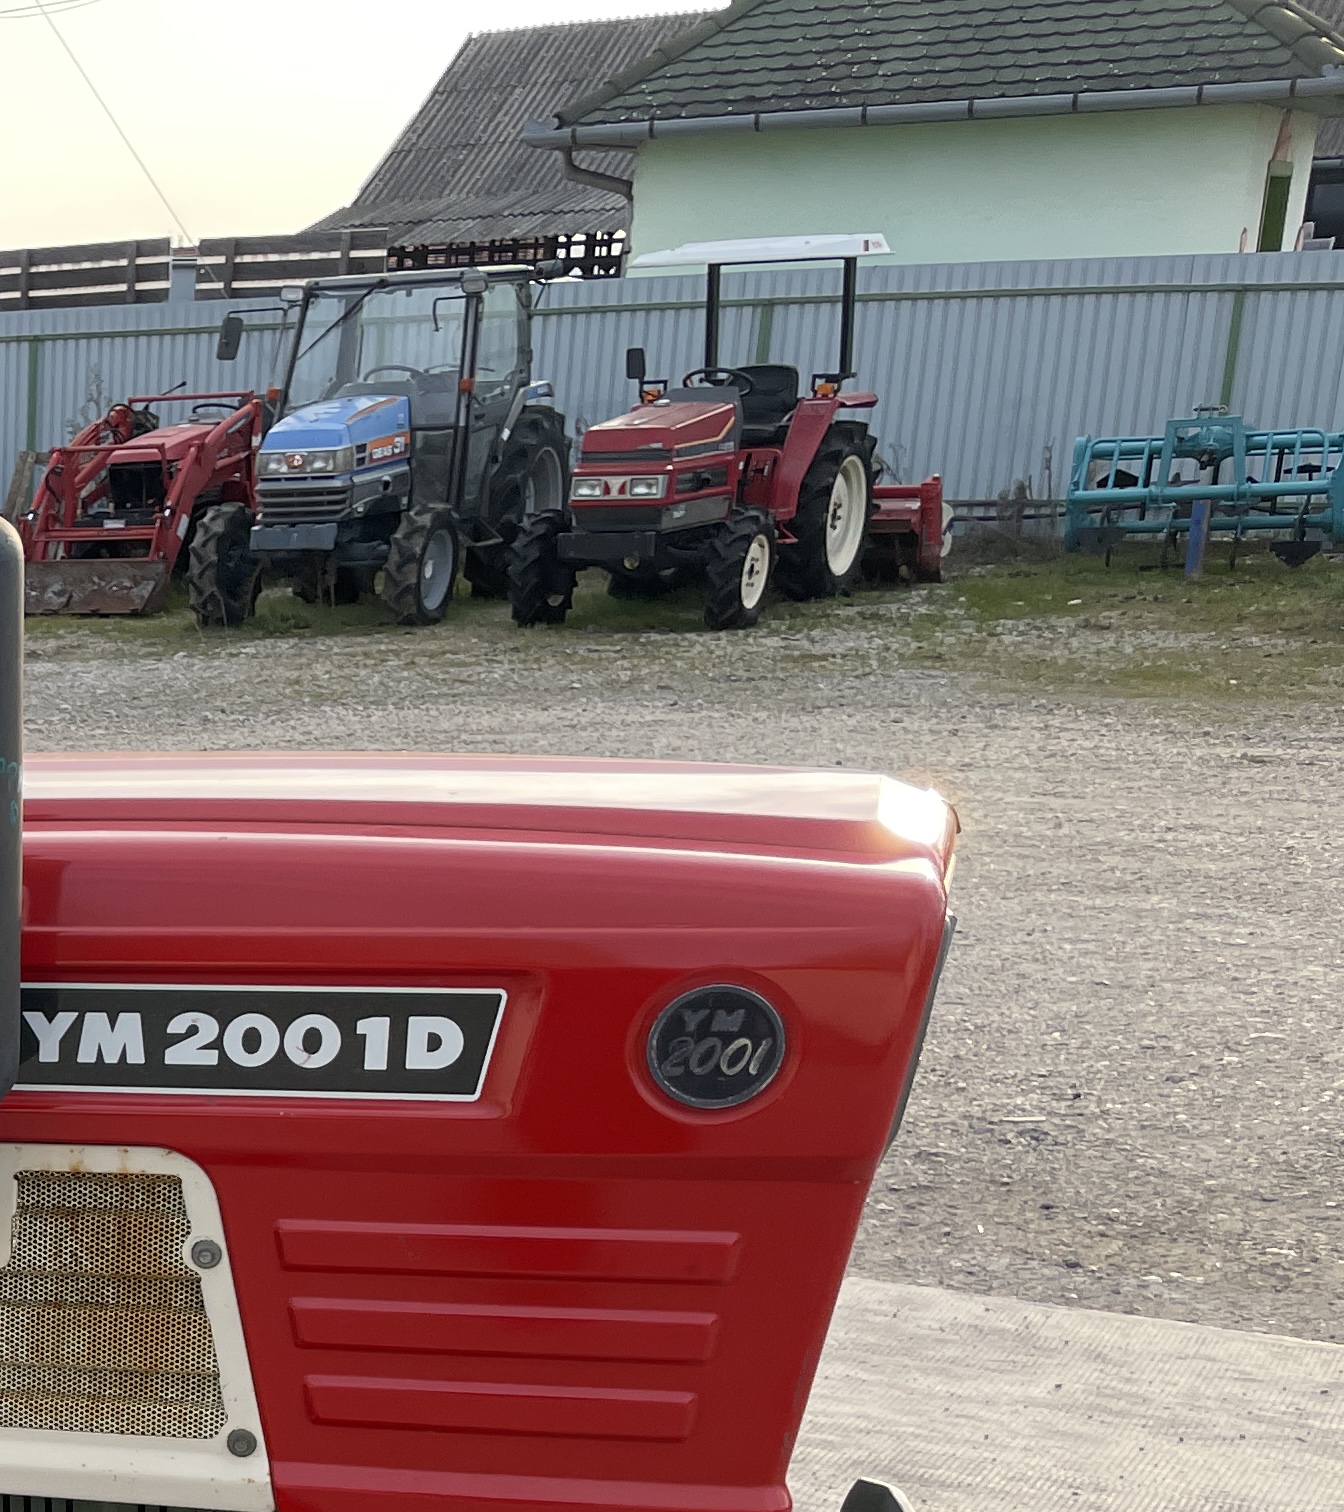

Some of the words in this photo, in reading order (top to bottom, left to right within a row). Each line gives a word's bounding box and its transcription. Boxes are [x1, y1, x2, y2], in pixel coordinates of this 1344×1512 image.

[680, 1008, 746, 1032] YM
[23, 1011, 145, 1064] YM
[164, 1011, 465, 1071] 2001D
[661, 1036, 773, 1077] 2001
